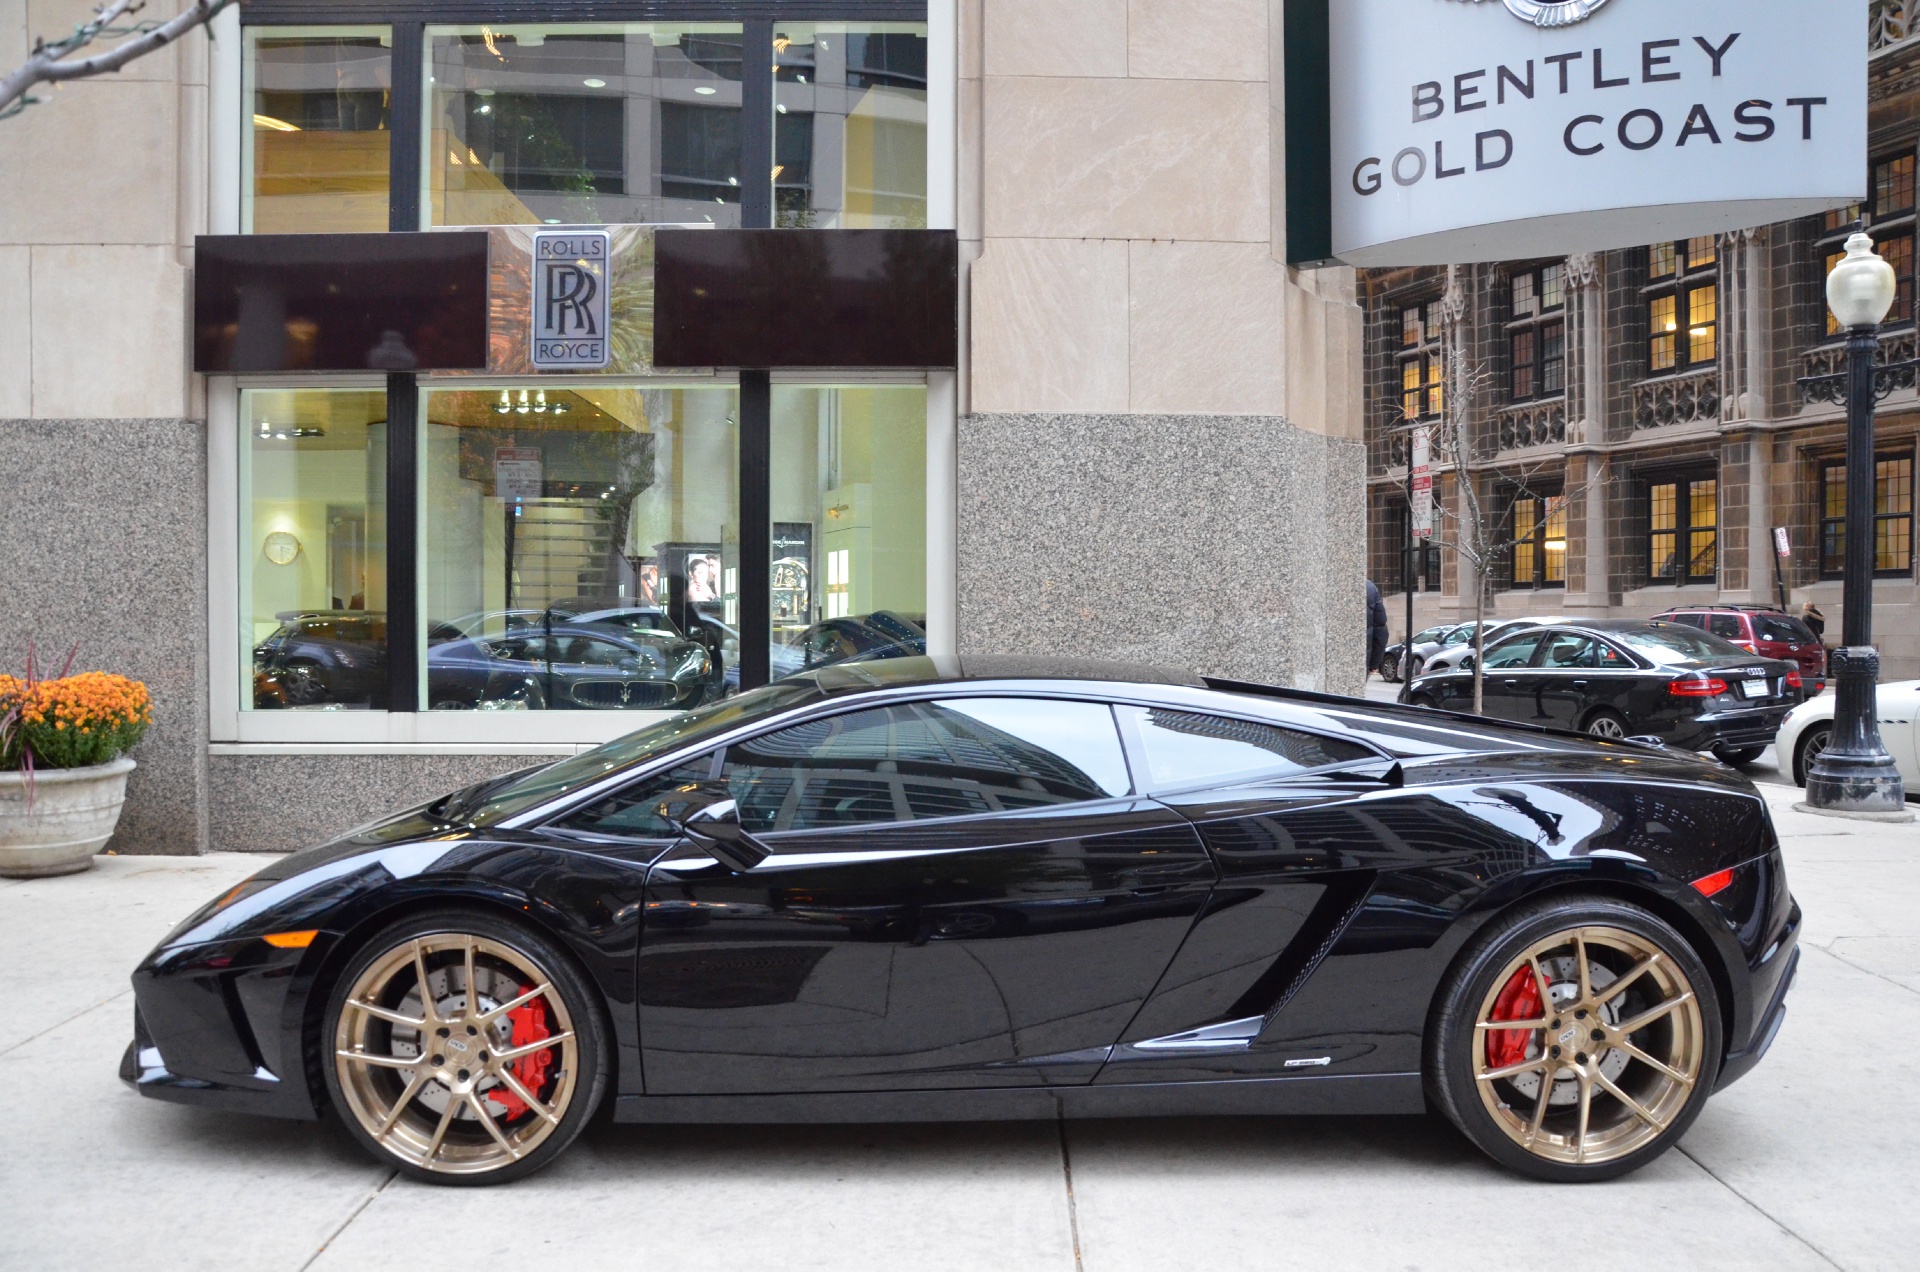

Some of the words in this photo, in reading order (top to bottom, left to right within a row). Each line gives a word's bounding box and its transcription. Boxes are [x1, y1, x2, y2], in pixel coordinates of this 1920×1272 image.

[1412, 32, 1741, 123] BENTLEY
[1352, 128, 1514, 197] GOLD
[1563, 96, 1828, 156] COAST
[540, 240, 600, 256] ROLLS
[539, 343, 600, 359] ROYCE
